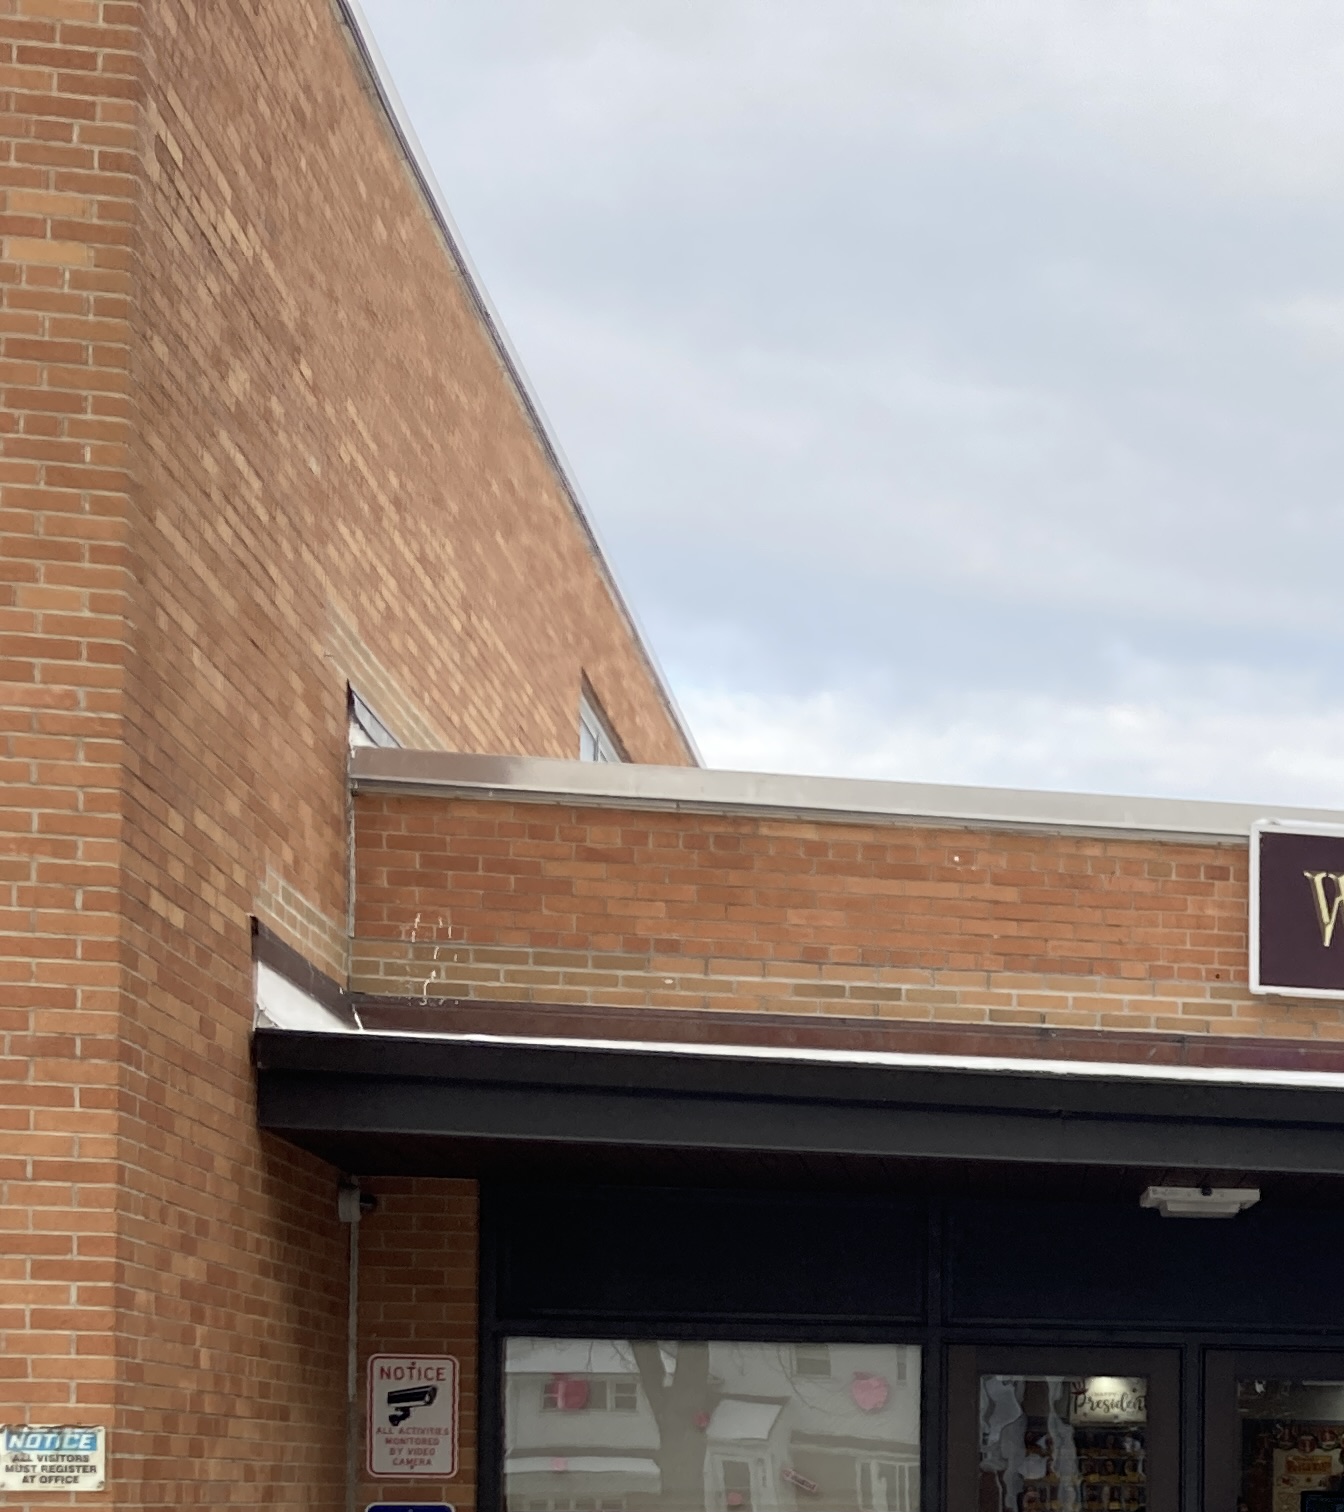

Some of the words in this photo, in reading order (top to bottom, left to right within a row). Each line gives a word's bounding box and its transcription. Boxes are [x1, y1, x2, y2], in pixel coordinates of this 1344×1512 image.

[380, 1366, 447, 1381] NOTICE
[376, 1427, 394, 1435] ALL
[399, 1427, 450, 1436] ACTIVITIES
[8, 1433, 95, 1450] NOTICE
[385, 1437, 440, 1446] MONITORED
[389, 1448, 403, 1456] BY
[408, 1448, 436, 1456] VIDEO
[12, 1454, 33, 1463] ALL
[37, 1454, 90, 1463] VISITORS
[392, 1458, 432, 1466] CAMERA
[5, 1465, 37, 1474] MUST
[40, 1465, 97, 1474] REGISTER
[22, 1475, 36, 1484] AT
[39, 1475, 79, 1484] OFFICE
